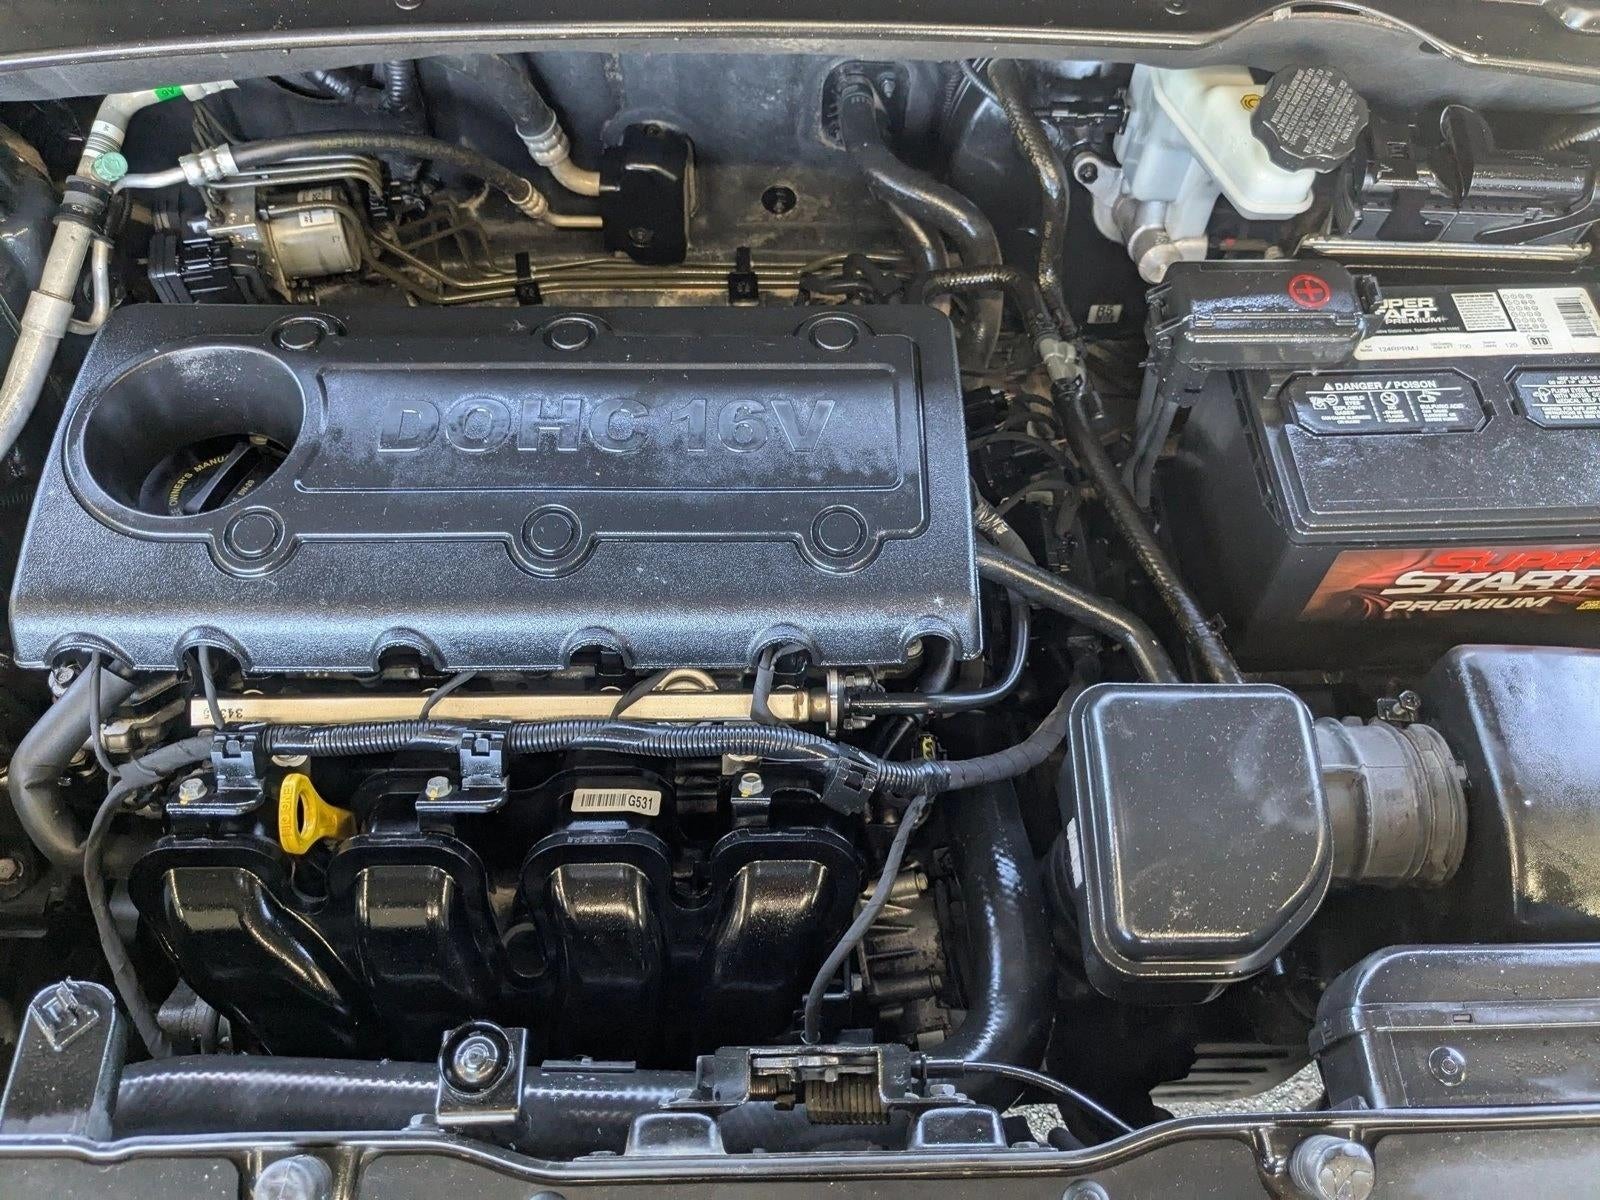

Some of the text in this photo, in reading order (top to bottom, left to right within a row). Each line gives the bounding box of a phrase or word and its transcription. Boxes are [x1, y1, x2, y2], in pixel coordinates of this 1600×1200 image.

[1385, 316, 1442, 325] PREMIUM
[1530, 337, 1549, 345] STD
[1334, 382, 1383, 391] DANGER
[1394, 380, 1437, 389] POISON
[377, 397, 837, 453] DOHC 16V
[168, 472, 193, 507] OWNER'S
[1379, 570, 1600, 595] START
[1384, 597, 1553, 612] PREMIUM
[628, 794, 654, 811] G531
